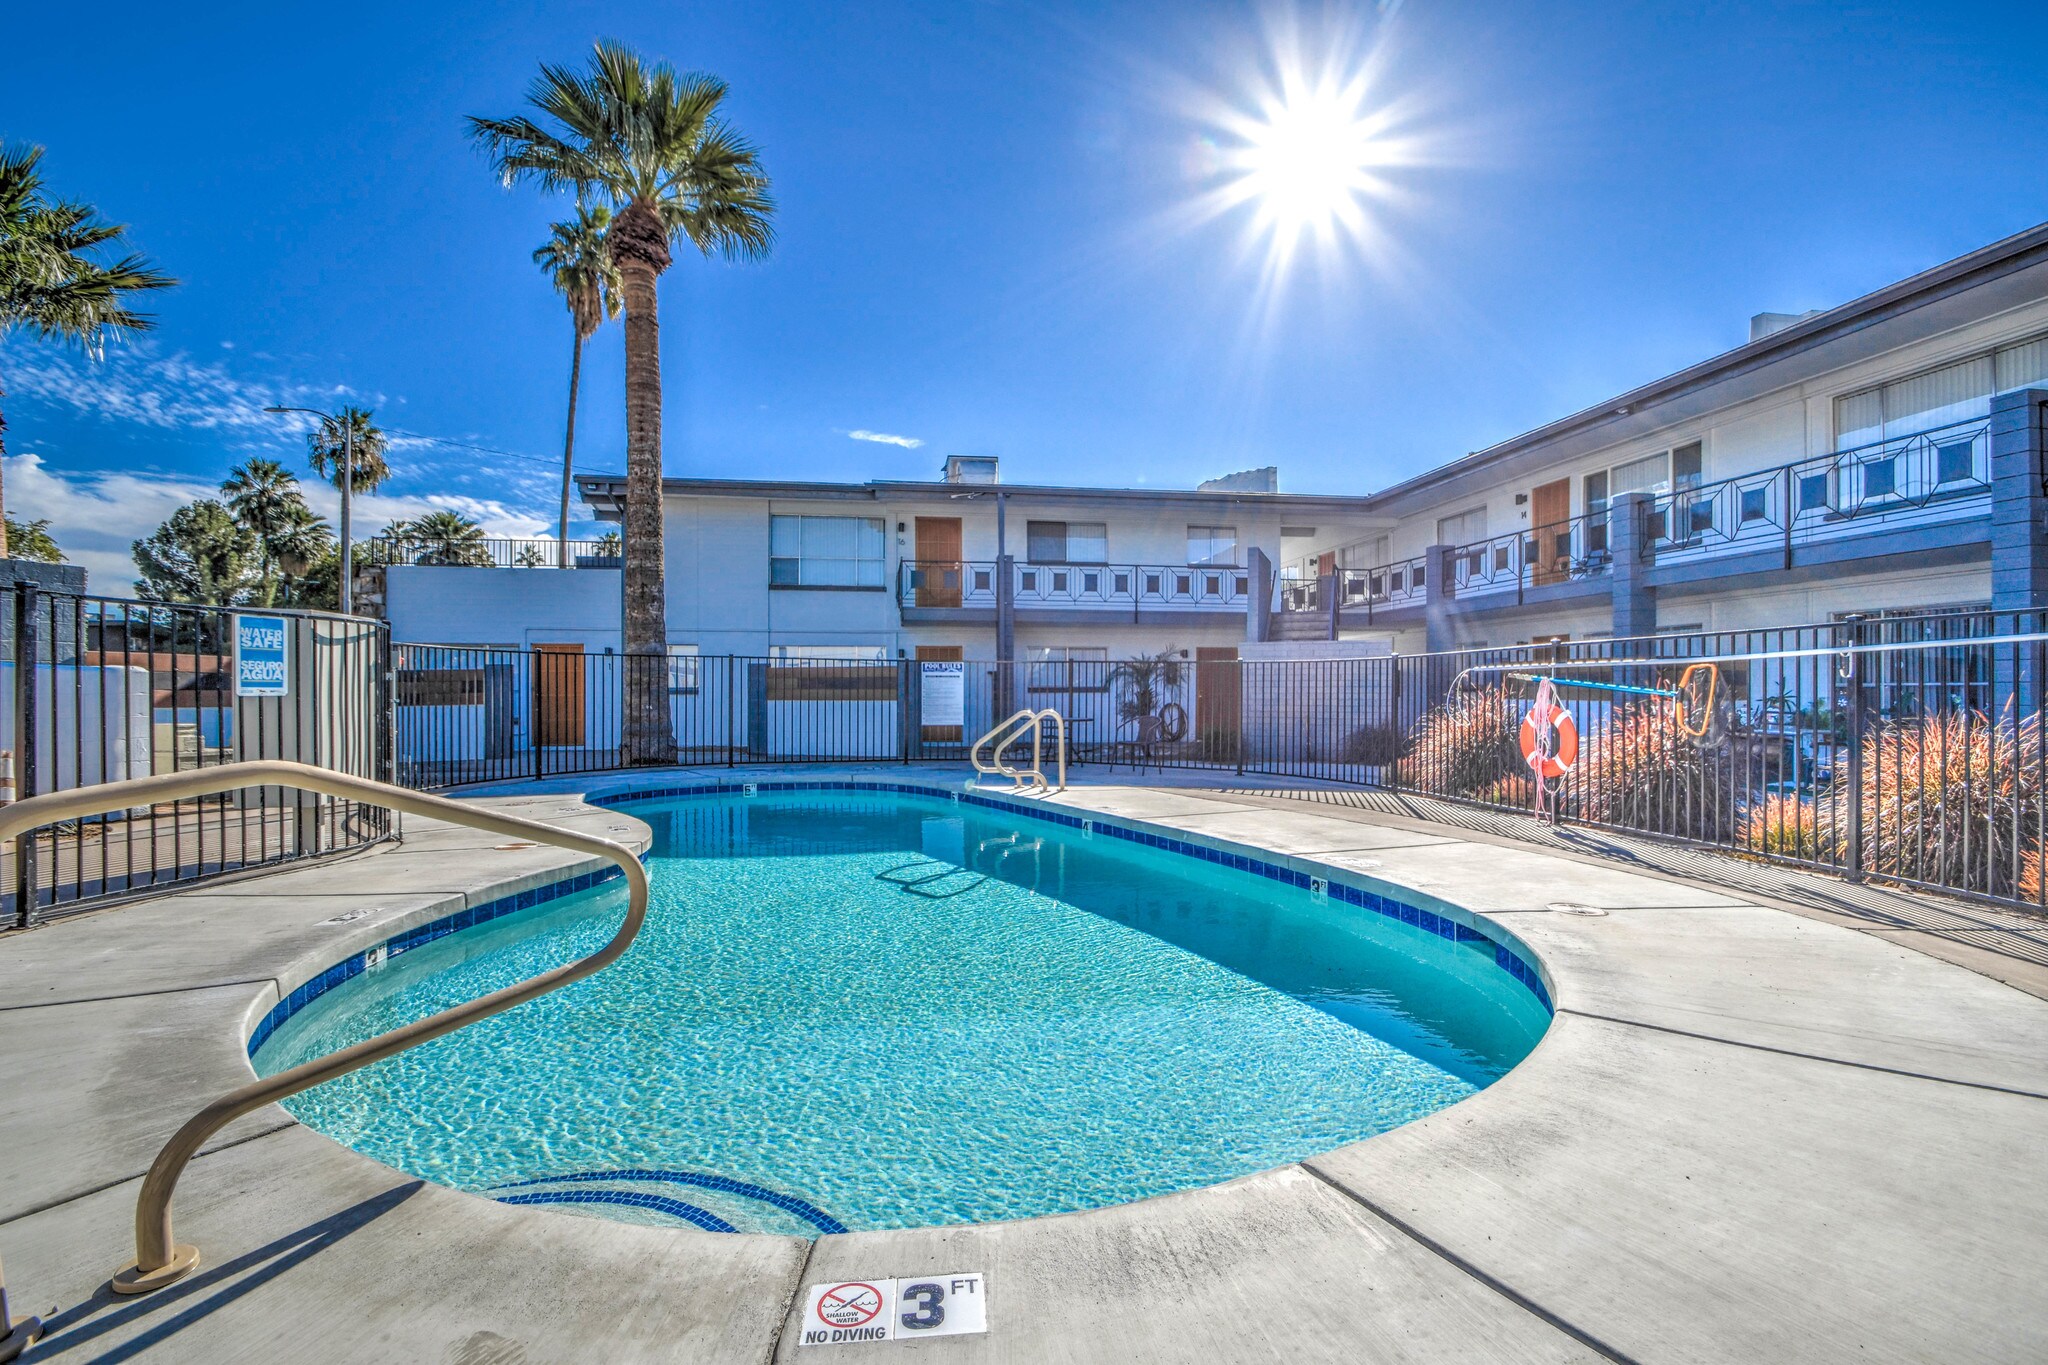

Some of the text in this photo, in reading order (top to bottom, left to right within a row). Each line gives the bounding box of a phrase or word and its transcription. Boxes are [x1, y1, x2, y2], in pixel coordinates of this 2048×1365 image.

[240, 627, 283, 641] WATER
[241, 637, 283, 649] SAFE
[241, 660, 284, 671] SEGURO
[241, 669, 283, 680] AGUA
[901, 1279, 979, 1330] 3 FT
[826, 1311, 859, 1319] SHALLOW
[836, 1316, 859, 1324] WATER
[805, 1326, 886, 1344] NO DIVING
